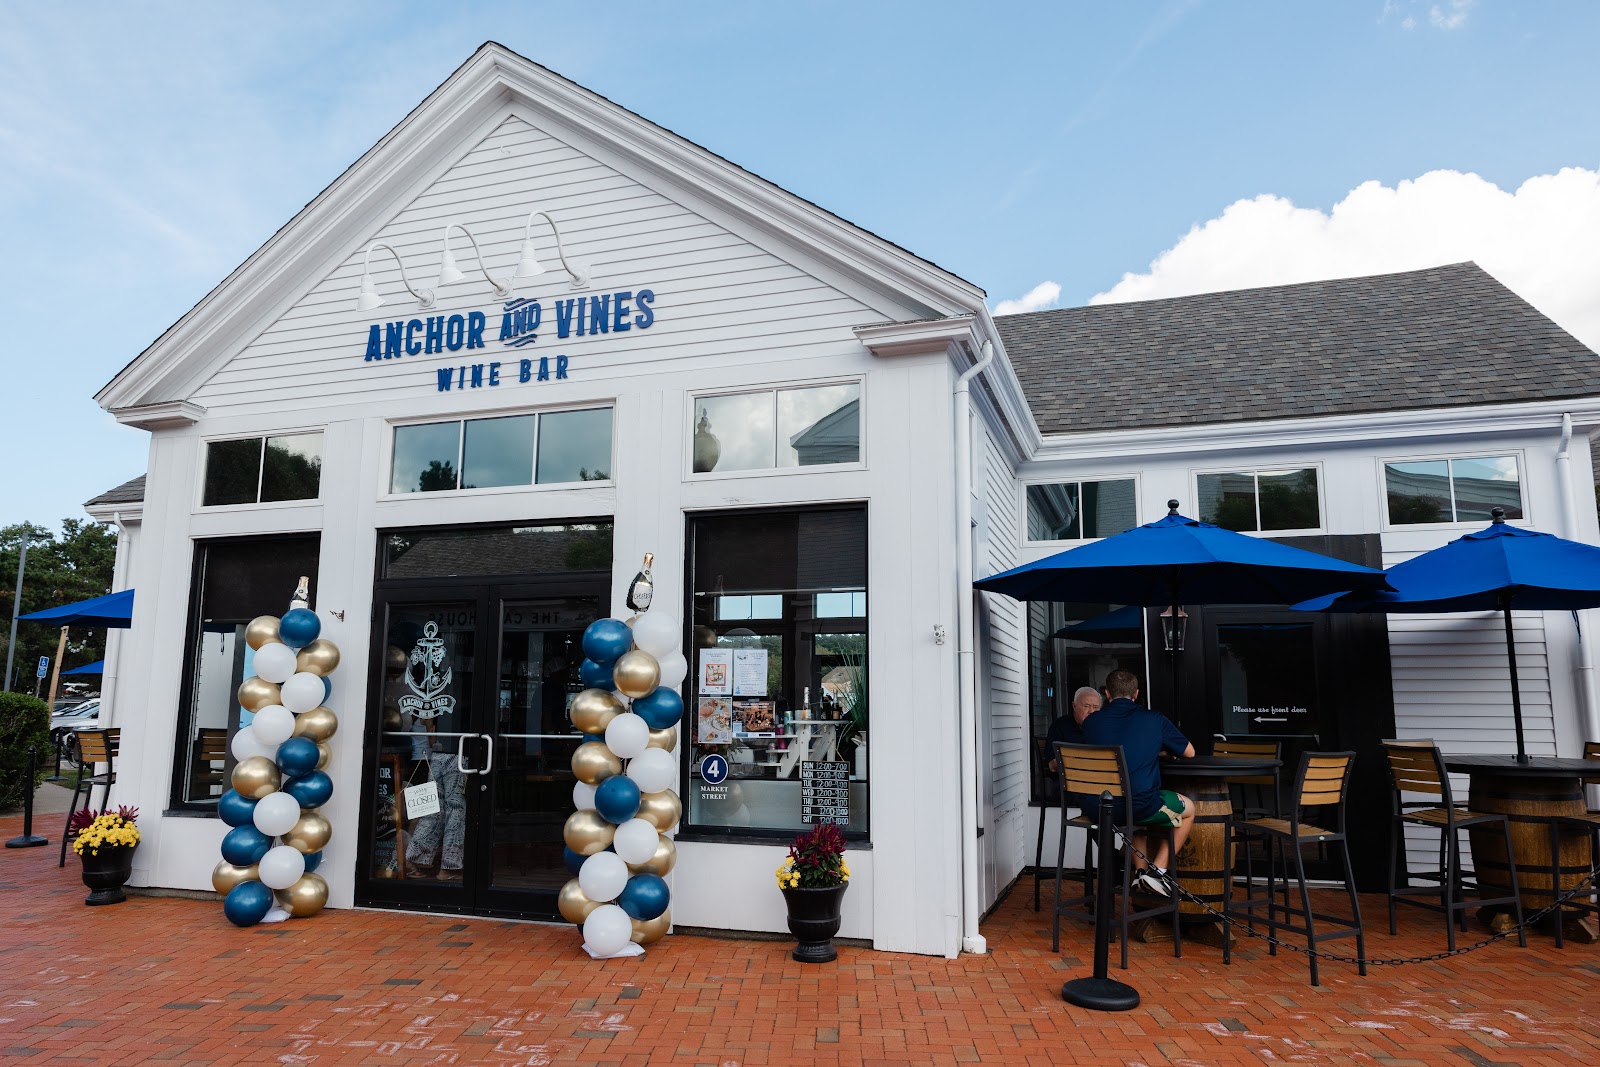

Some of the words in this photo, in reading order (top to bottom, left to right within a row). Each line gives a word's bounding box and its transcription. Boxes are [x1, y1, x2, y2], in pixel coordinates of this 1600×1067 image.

[364, 310, 486, 362] ANCHOR
[499, 303, 542, 341] AND
[555, 289, 655, 338] VINES
[437, 362, 501, 392] WINE
[519, 355, 569, 383] BAR
[430, 697, 449, 708] VINES
[1232, 705, 1256, 713] Please
[1271, 705, 1289, 715] front
[1291, 705, 1307, 713] door
[707, 759, 720, 778] 4
[802, 762, 814, 770] SUN
[700, 785, 729, 793] MARKET
[407, 793, 437, 808] CLOSED
[802, 815, 813, 823] SAT
